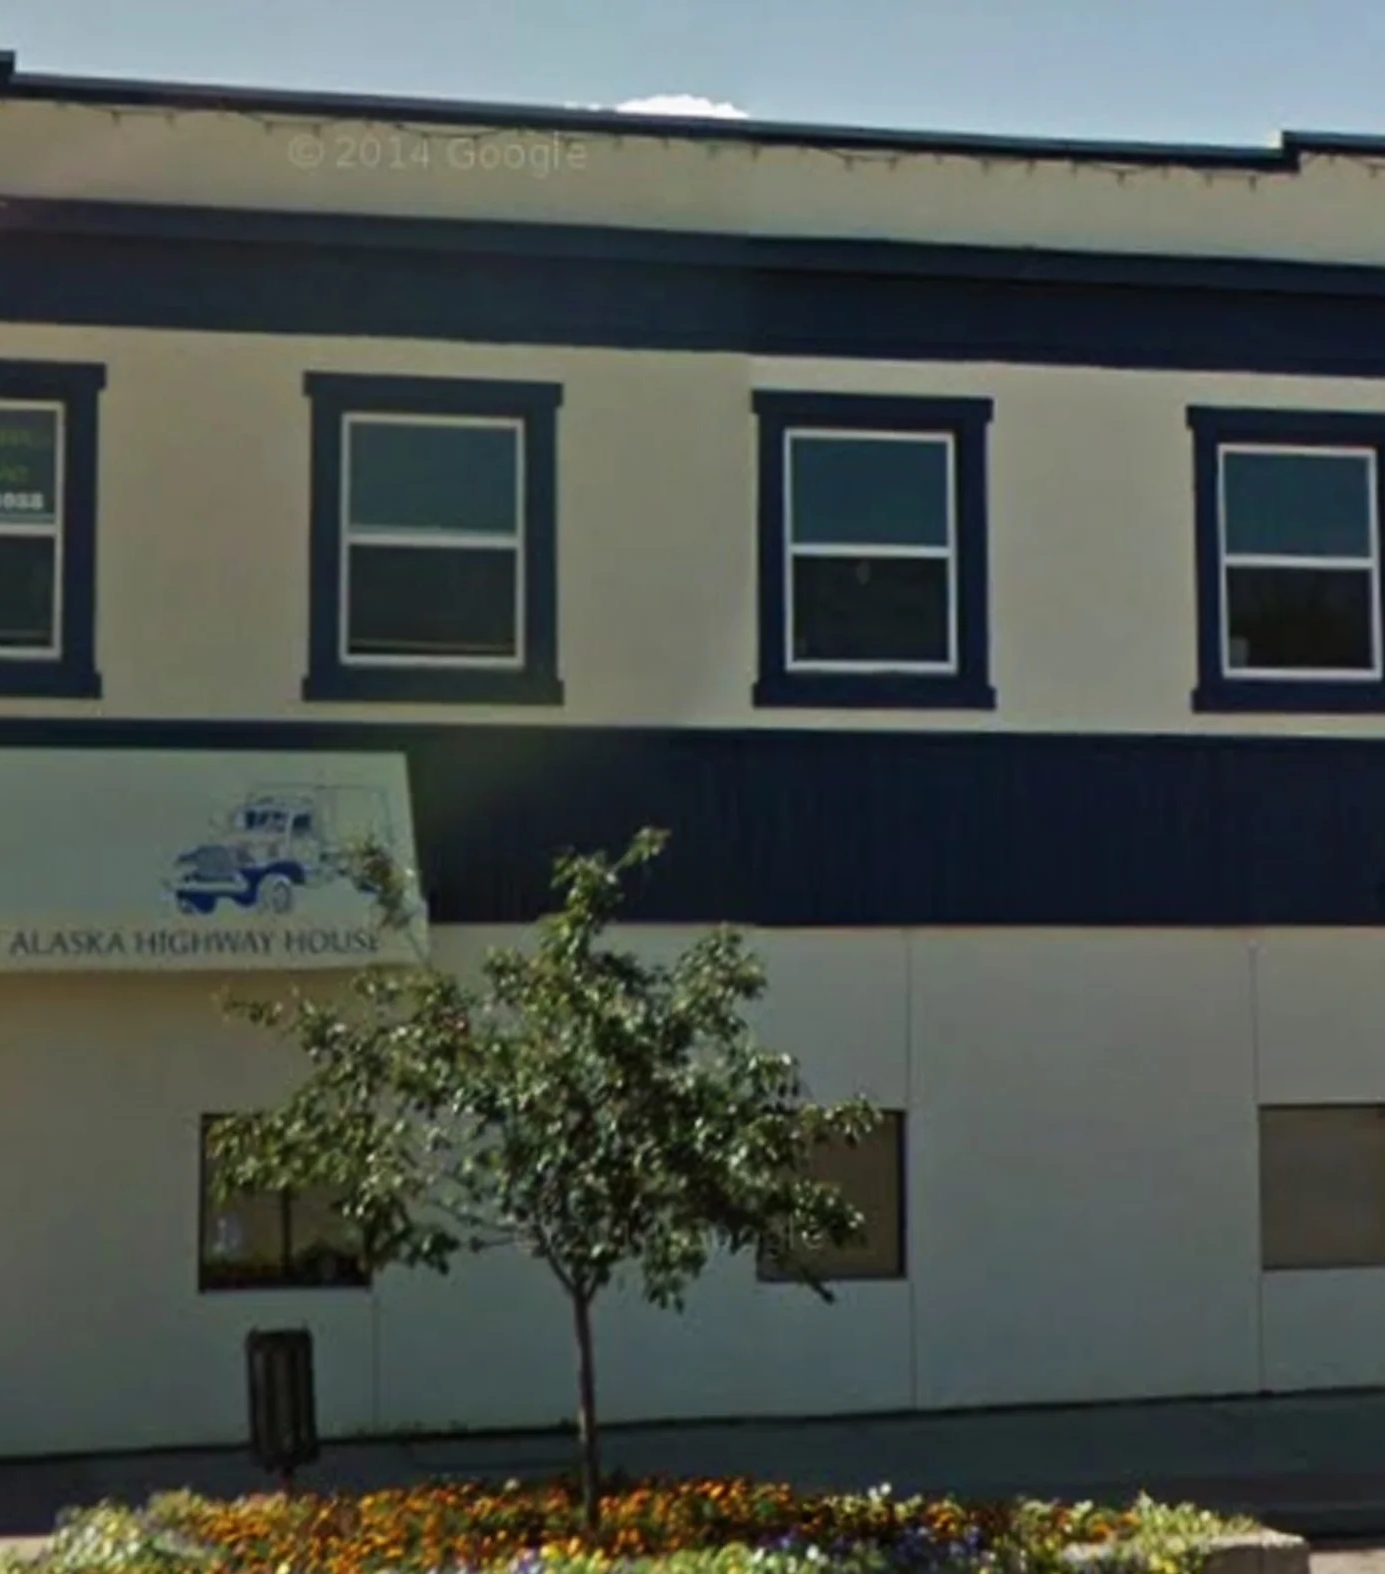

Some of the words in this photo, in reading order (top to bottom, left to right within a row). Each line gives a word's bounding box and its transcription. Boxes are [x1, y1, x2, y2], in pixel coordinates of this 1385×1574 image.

[9, 929, 125, 957] ALASKA
[134, 928, 274, 957] HIGHWAY
[285, 928, 381, 953] HOUSE
